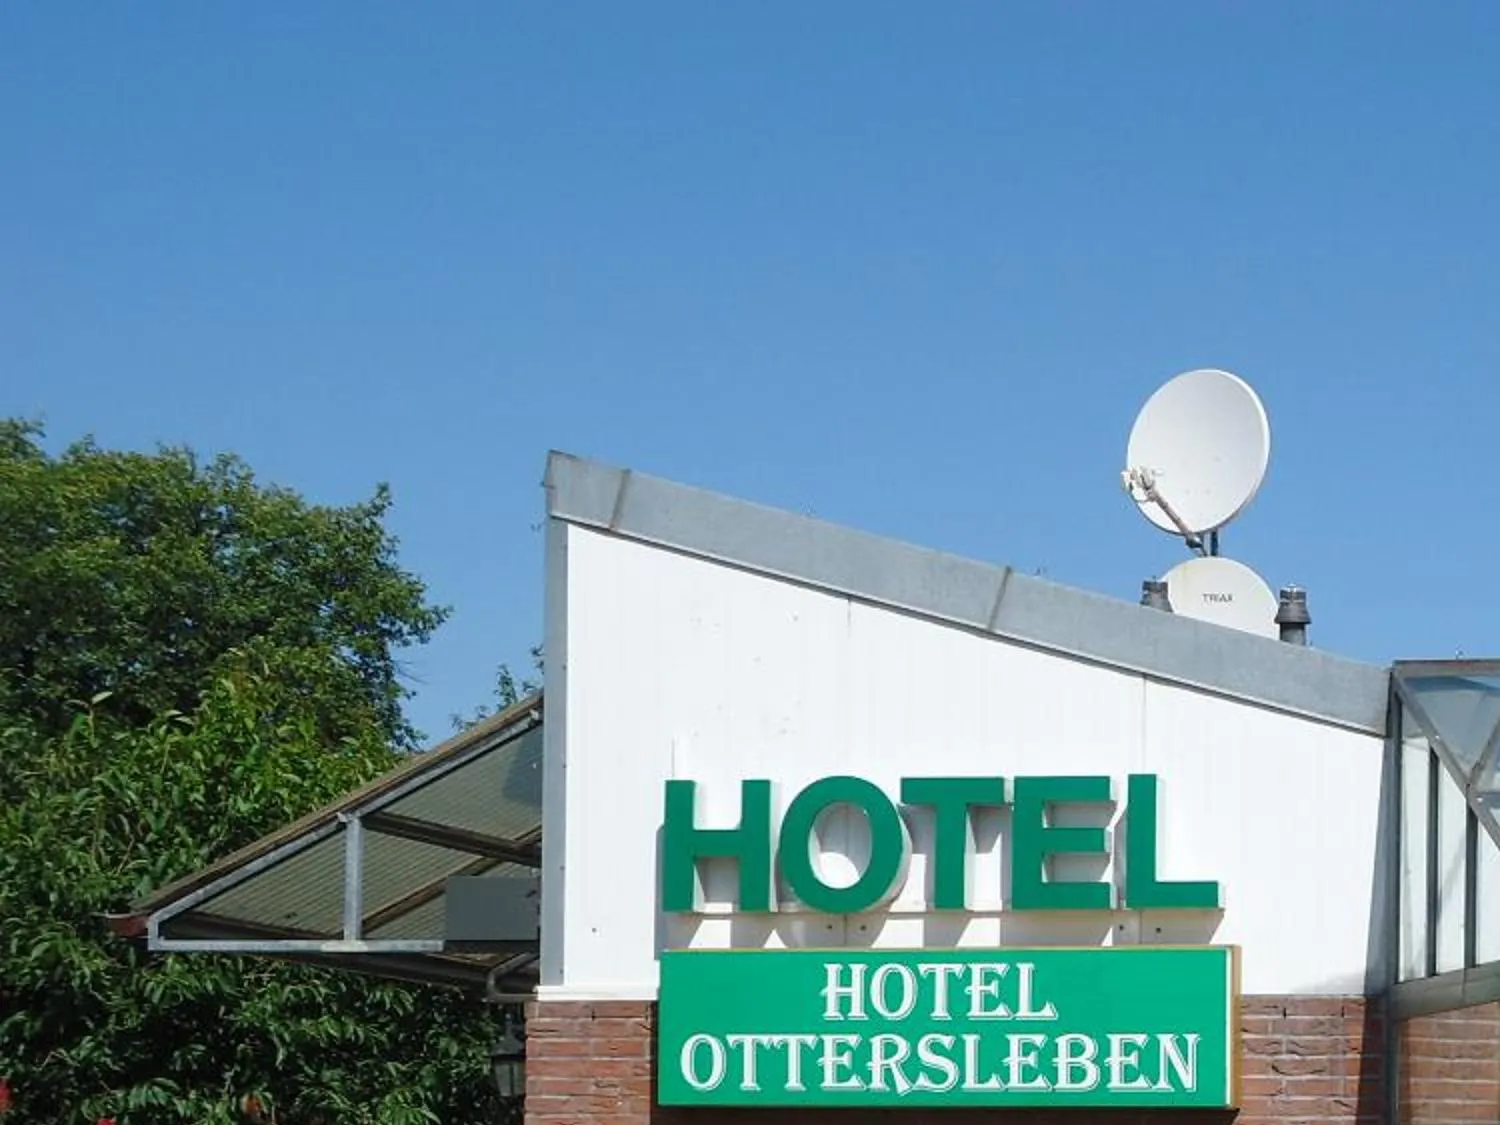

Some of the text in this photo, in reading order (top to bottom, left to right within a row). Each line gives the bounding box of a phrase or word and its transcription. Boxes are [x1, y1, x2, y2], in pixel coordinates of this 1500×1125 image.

[662, 774, 1219, 912] HOTEL
[820, 962, 1059, 1022] HOTEL
[680, 1032, 1202, 1097] OTTERSLEBEN
